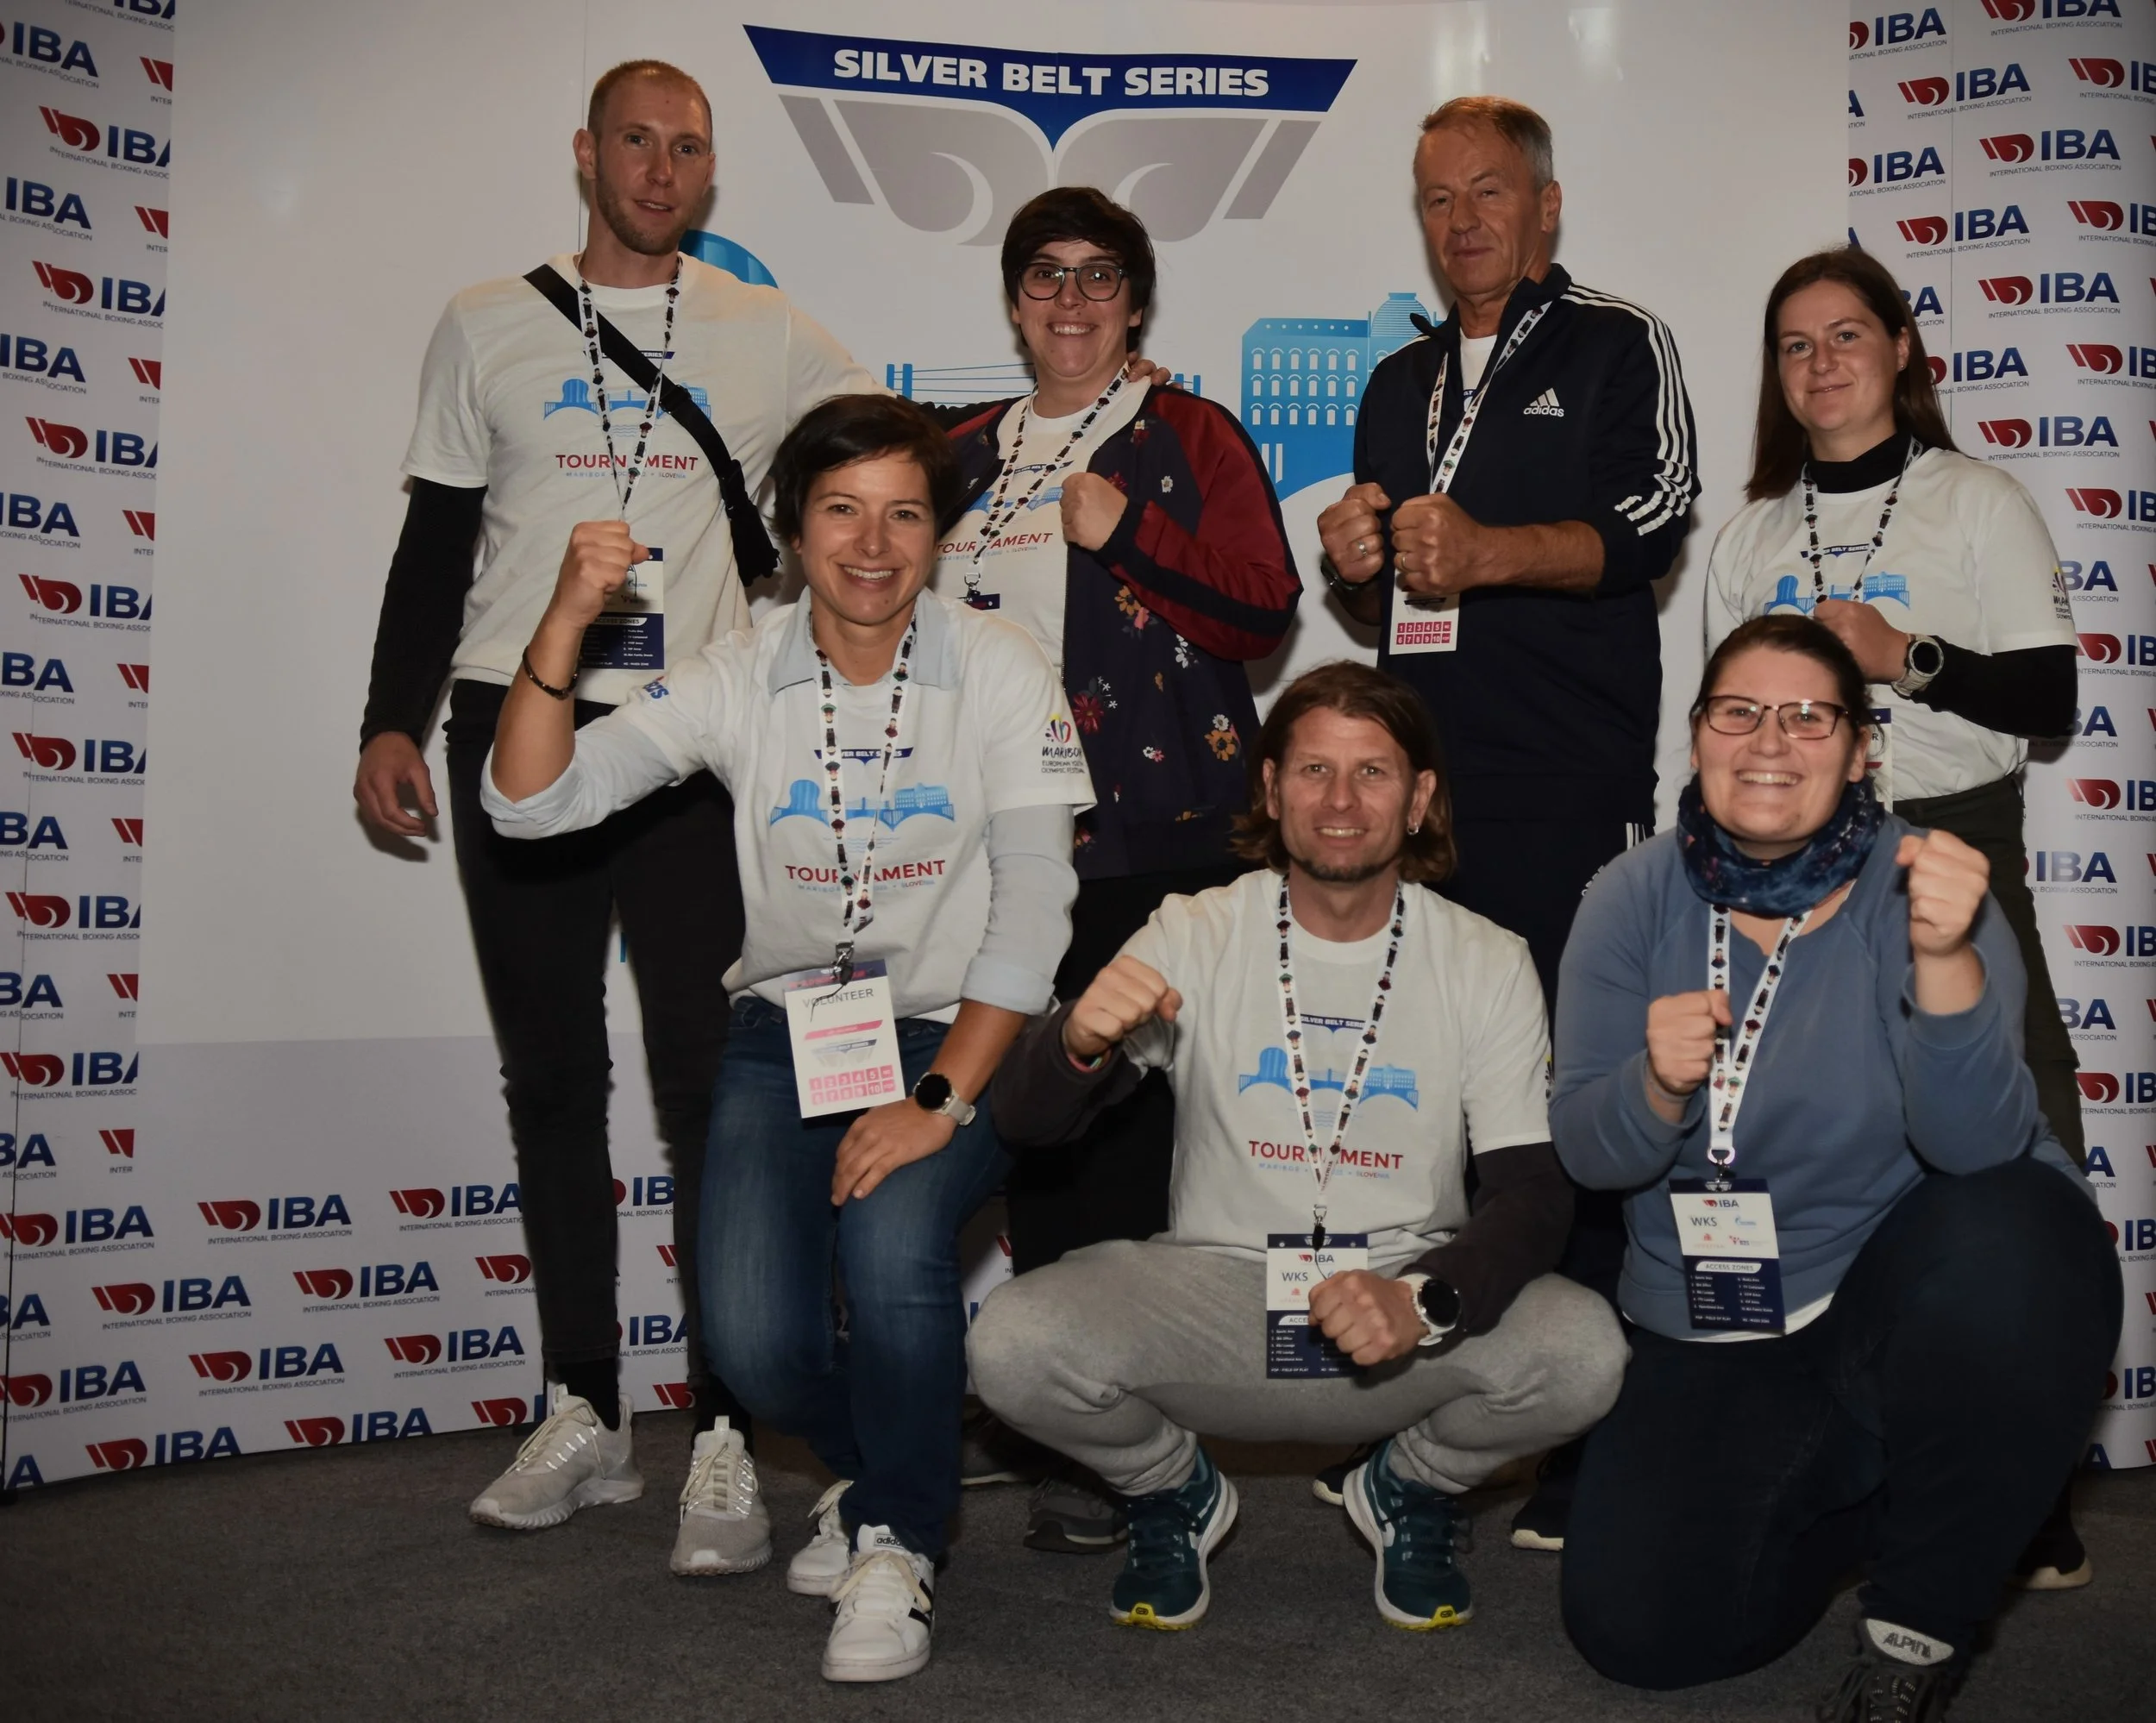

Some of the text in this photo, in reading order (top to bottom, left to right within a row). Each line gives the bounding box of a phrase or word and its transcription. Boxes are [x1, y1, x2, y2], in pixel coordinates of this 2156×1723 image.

[1875, 8, 1946, 46] IBA
[1991, 24, 2043, 36] INTERNATIONAL
[12, 22, 98, 78] IBA
[1878, 40, 1947, 56] BOXING ASSOCIATION
[16, 60, 47, 73] BOXING
[48, 68, 99, 89] ASSOCIATION
[833, 48, 1269, 97] SILVER BELT SERIES
[1956, 63, 2031, 102] IBA
[1908, 97, 2032, 120] INTERNATIONAL BOXING ASSOCIATION
[2041, 129, 2121, 160] IBA
[50, 147, 141, 174] INTERNATIONAL BOXING
[1874, 147, 1945, 184] IBA
[1990, 166, 2042, 178] INTERNATIONAL
[1877, 179, 1946, 194] BOXING ASSOCIATION
[6, 177, 91, 229] IBA
[9, 216, 92, 241] BOXING ASSOCIATION
[1955, 205, 2029, 241] IBA
[1906, 238, 2030, 259] INTERNATIONAL BOXING ASSOCIATION
[2040, 273, 2120, 304] IBA
[43, 301, 135, 324] INTERNATIONAL BOXING
[1989, 309, 2041, 319] INTERNATIONAL
[0, 333, 85, 383] IBA
[1953, 347, 2029, 382] IBA
[3, 373, 86, 394] BOXING ASSOCIATION
[1524, 405, 1564, 417] adidas
[2039, 416, 2120, 448] IBA
[36, 456, 129, 477] INTERNATIONAL BOXING
[555, 454, 698, 470] TOURNMENT
[1988, 452, 2042, 463] INTERNATIONAL
[2072, 450, 2120, 459] ASSOCIATION
[937, 533, 1053, 554] TOURAMENT
[29, 612, 124, 630] INTERNATIONAL BOXING
[23, 772, 85, 784] INTERNATIONAL
[2036, 850, 2118, 884] IBA
[78, 895, 141, 928] IB
[16, 930, 79, 940] INTERNATIONAL
[802, 988, 874, 1008] VOLUNTEER
[10, 1091, 72, 1101] INTERNATIONAL
[452, 1183, 523, 1217] IBA
[267, 1194, 352, 1230] IBA
[1690, 1217, 1718, 1226] WKS
[65, 1206, 154, 1244] IBA
[208, 1230, 352, 1244] INTERNATIONAL BOXING ASSOCIATION
[69, 1246, 99, 1256] BOXING
[101, 1242, 154, 1251] ASSOCIATION
[360, 1262, 439, 1297] IBA
[1282, 1272, 1308, 1281] WKS
[162, 1275, 251, 1313] IBA
[303, 1303, 360, 1313] INTERNATIONAL
[392, 1296, 440, 1306] ASSOCIATION
[102, 1311, 252, 1331] INTERNATIONAL BOXING ASSOCIATION
[448, 1326, 524, 1362] IBA
[260, 1344, 344, 1380] IBA
[393, 1368, 449, 1378] INTERNATIONAL
[479, 1359, 525, 1369] ASSOCIATION
[60, 1360, 146, 1403] IBA
[199, 1386, 259, 1396] INTERNATIONAL
[293, 1378, 345, 1388] ASSOCIATION
[63, 1397, 147, 1415] BOXING ASSOCIATION
[352, 1407, 433, 1441] IBA
[154, 1426, 241, 1465] IBA
